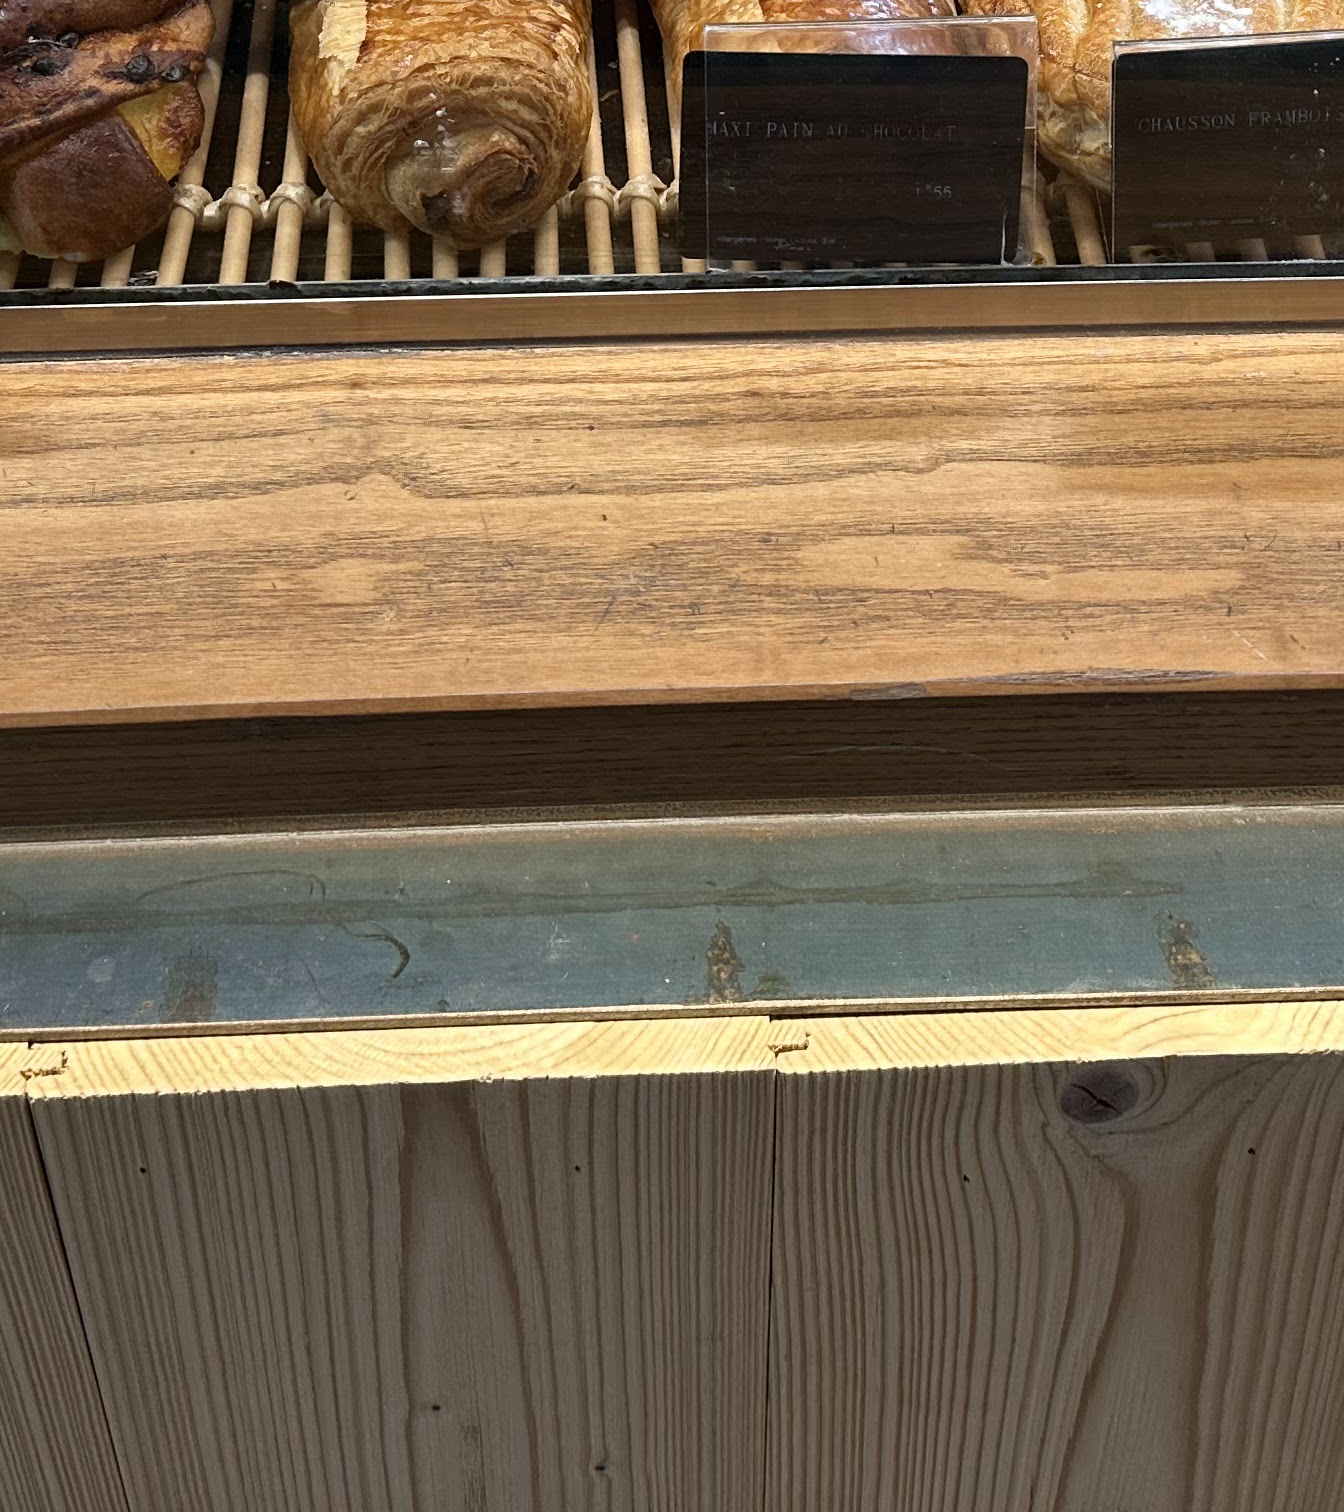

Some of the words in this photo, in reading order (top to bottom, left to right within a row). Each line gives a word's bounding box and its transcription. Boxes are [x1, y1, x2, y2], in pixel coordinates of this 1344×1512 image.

[705, 120, 753, 137] MAXI
[766, 121, 814, 137] PAIN
[825, 122, 849, 137] AU
[860, 123, 958, 142] HOCOLAT
[1138, 112, 1238, 134] CHAUSSON
